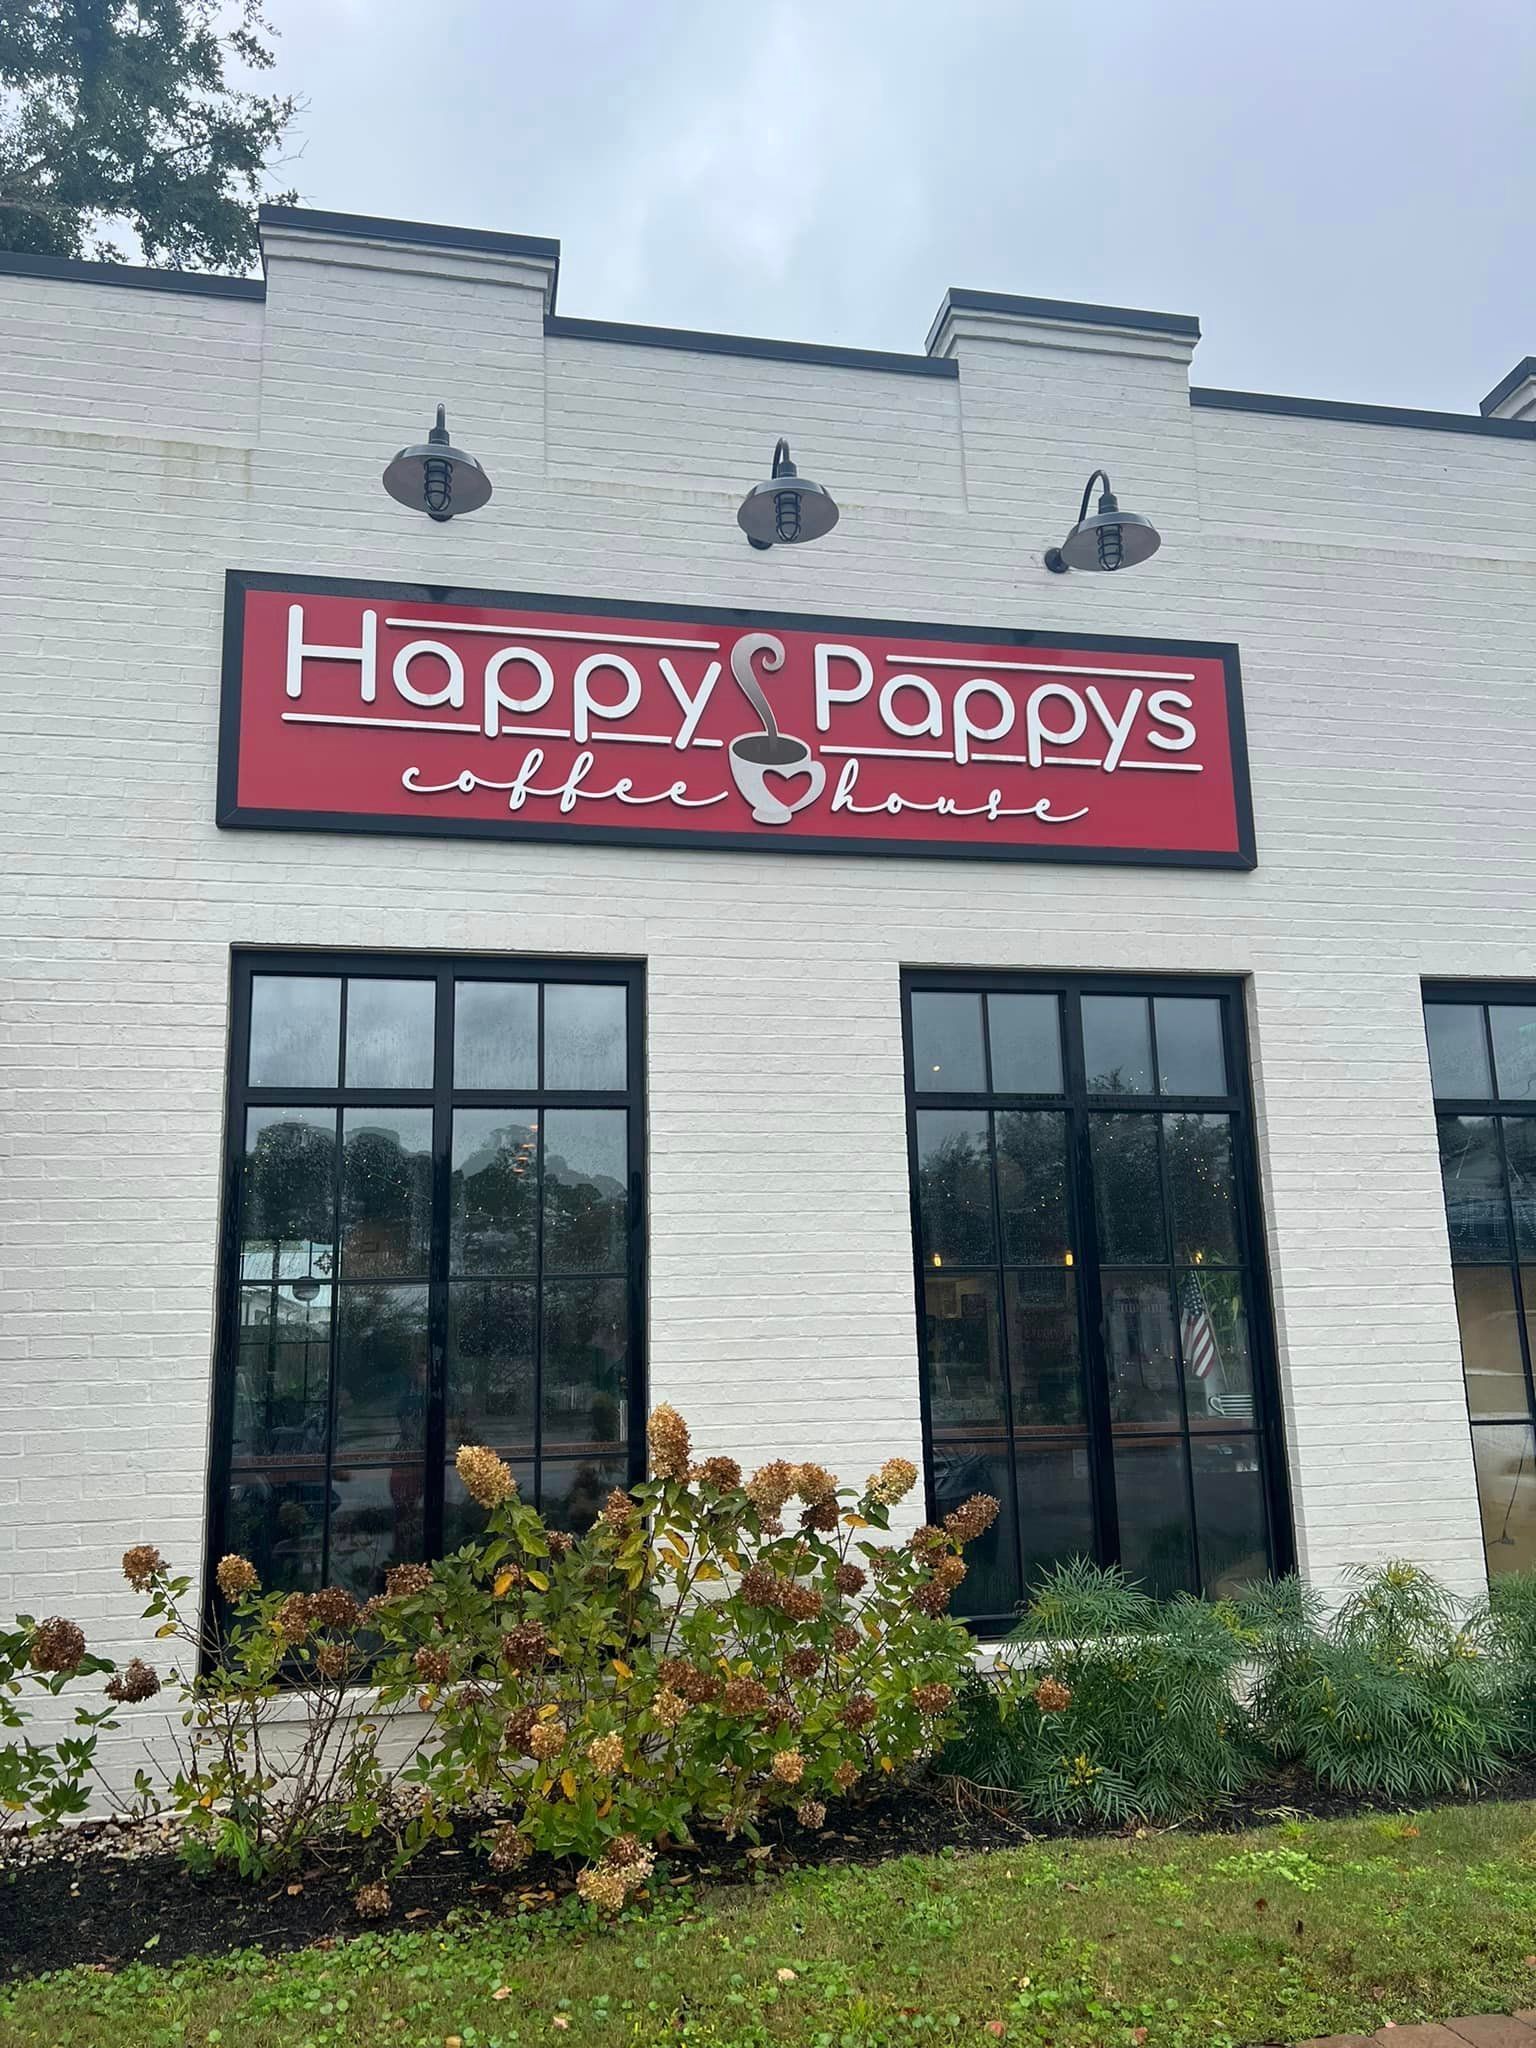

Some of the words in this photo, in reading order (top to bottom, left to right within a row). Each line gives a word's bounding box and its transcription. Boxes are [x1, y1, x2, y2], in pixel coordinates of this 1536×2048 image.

[286, 603, 722, 749] Happy
[813, 642, 1198, 773] Pappys
[402, 748, 728, 813] coffee
[831, 758, 1089, 823] house
